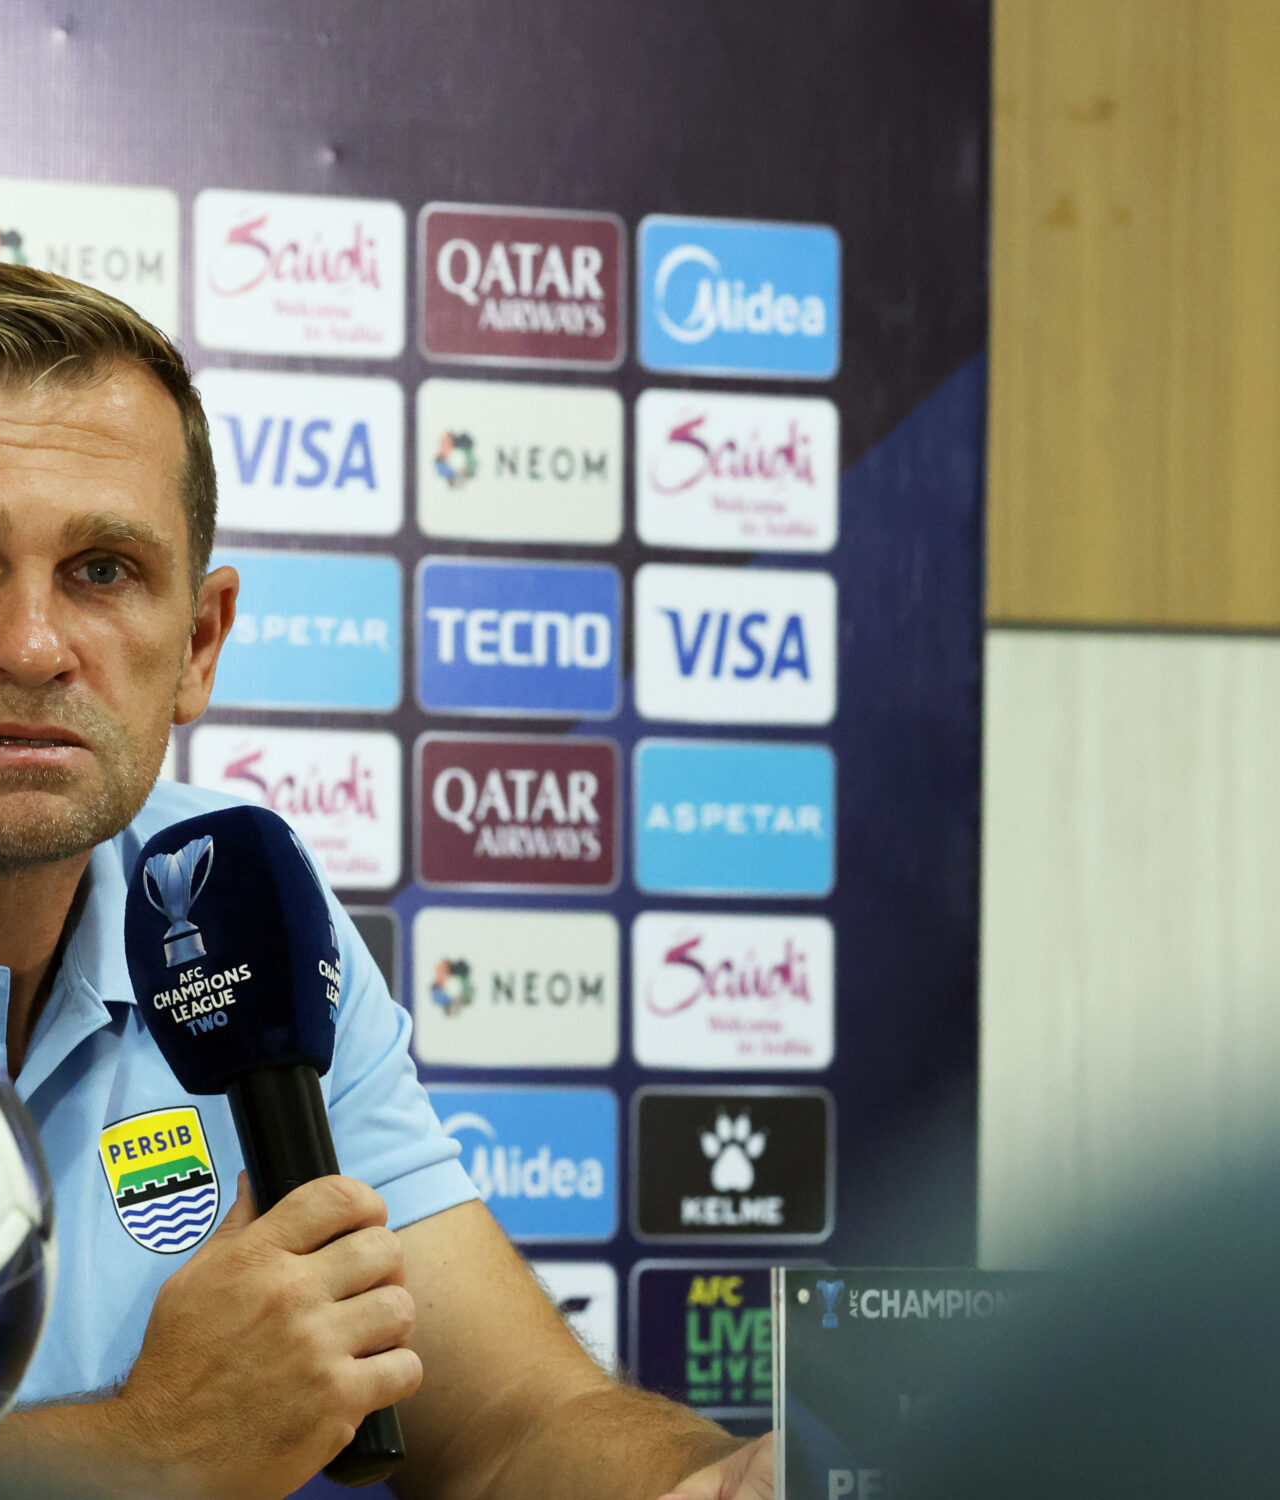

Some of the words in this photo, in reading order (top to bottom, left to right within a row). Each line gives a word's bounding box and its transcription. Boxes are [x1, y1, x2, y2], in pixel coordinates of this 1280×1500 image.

[47, 244, 164, 283] NEOM
[437, 239, 604, 305] QATAR
[479, 298, 606, 336] AIRWAYS
[218, 414, 377, 490] VISA
[495, 447, 608, 481] NEOM
[230, 614, 390, 652] SPETAR
[427, 608, 611, 669] TECNO
[656, 606, 812, 683] VISA
[432, 767, 600, 833] QATAR
[645, 801, 823, 838] ASPETAR
[474, 827, 602, 862] AIRWAYS
[153, 964, 252, 1010] CHAMPIONS
[179, 966, 204, 985] AFC
[491, 971, 605, 1006] NEOM
[171, 988, 236, 1023] LEAGUE
[186, 1010, 228, 1037] TWO
[108, 1124, 193, 1164] PERSIB
[680, 1196, 784, 1226] KELME
[687, 1275, 744, 1307] AFC
[849, 1289, 859, 1318] AFC
[686, 1308, 772, 1355] LIVE
